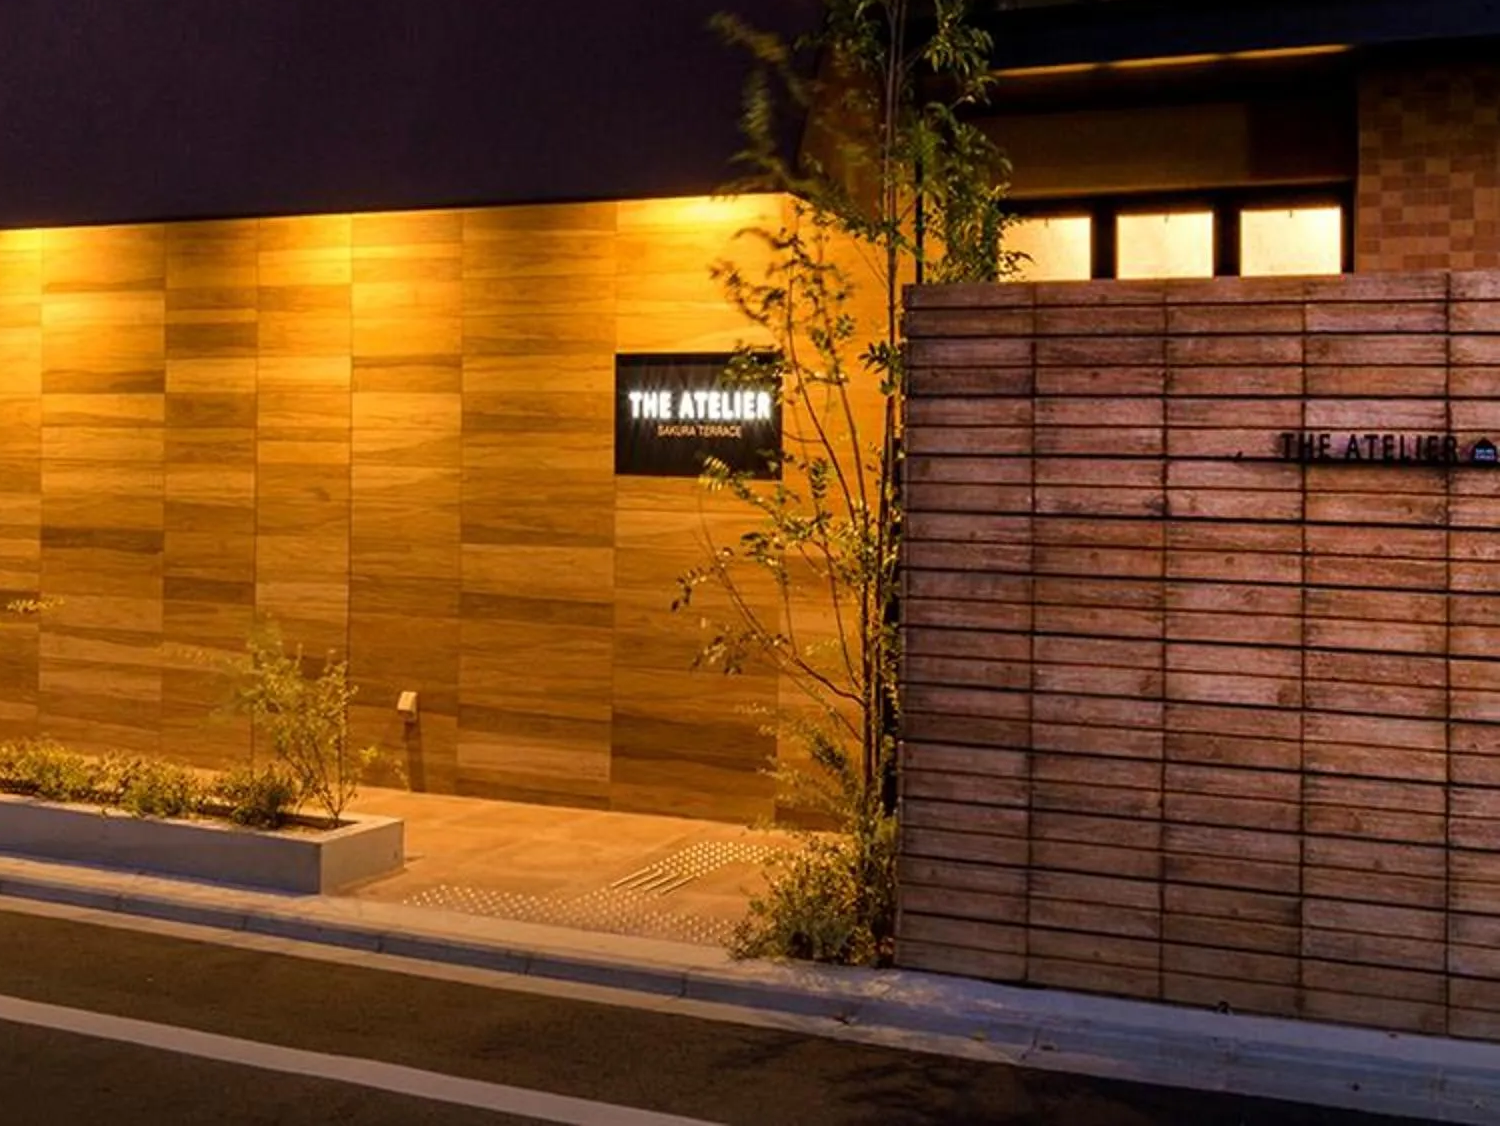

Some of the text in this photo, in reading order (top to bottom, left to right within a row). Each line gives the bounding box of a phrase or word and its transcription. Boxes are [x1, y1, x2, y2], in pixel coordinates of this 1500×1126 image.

[628, 390, 773, 420] THE ATELIER
[657, 425, 742, 438] SAKURA TERRACE
[1281, 433, 1331, 461] THE
[1346, 433, 1459, 464] ATELIER
